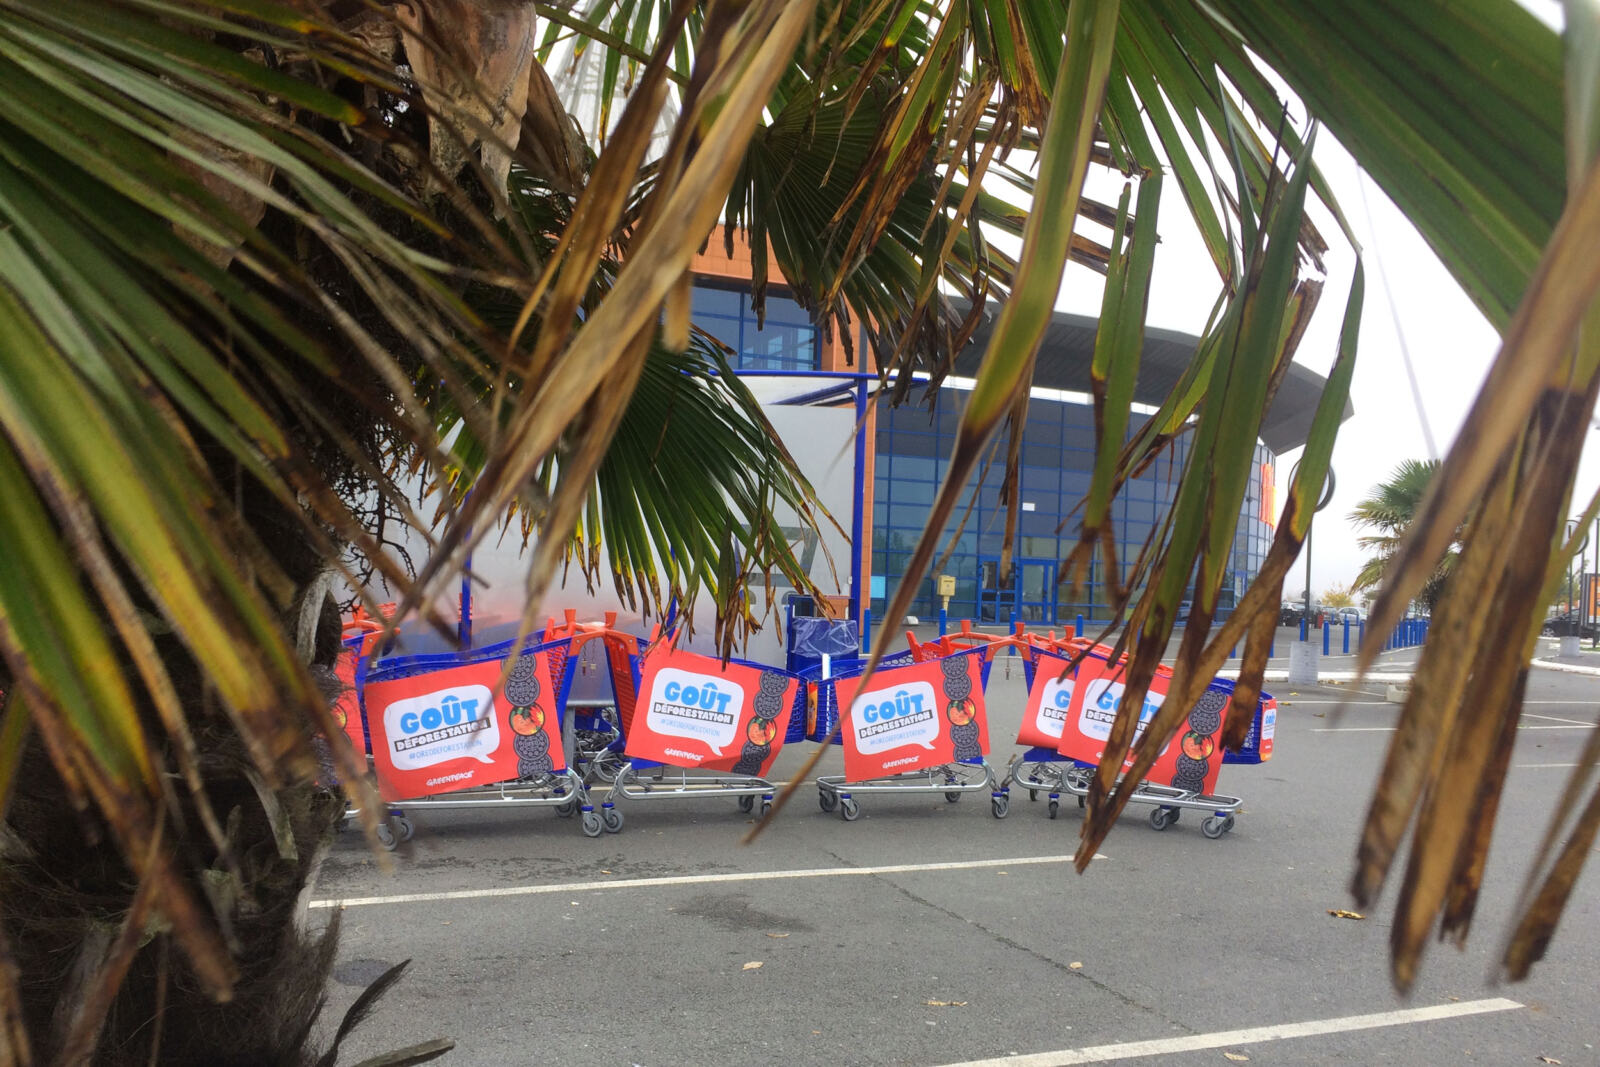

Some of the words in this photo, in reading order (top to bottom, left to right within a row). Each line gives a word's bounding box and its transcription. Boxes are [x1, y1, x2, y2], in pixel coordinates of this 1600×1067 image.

[664, 681, 732, 714] GOÛT
[863, 690, 924, 723] GOÛT
[400, 695, 479, 734] GOÛT
